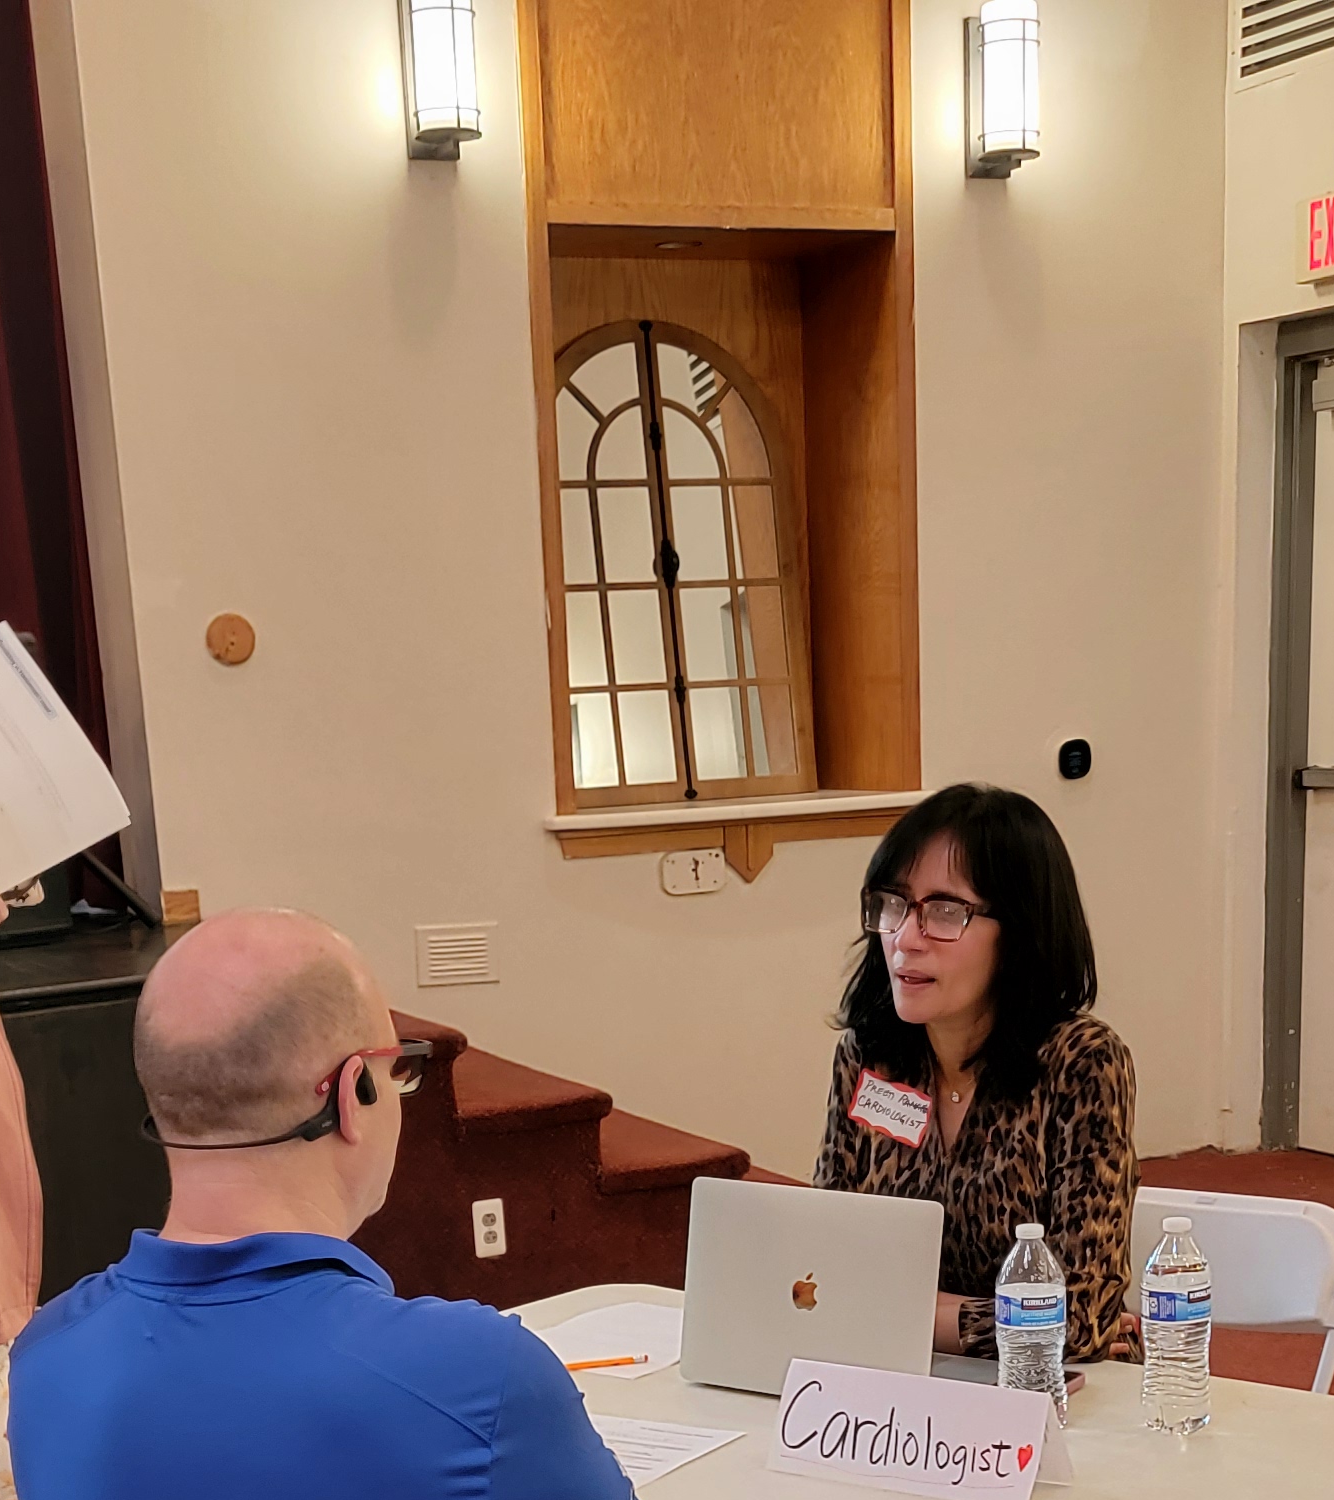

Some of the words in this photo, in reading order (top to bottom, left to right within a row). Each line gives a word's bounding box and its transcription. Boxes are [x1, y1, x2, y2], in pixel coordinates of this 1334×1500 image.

[857, 1094, 927, 1130] CARDIOLOGIST
[1023, 1297, 1057, 1307] KIRKLAND
[781, 1380, 1012, 1486] Cardiologist
